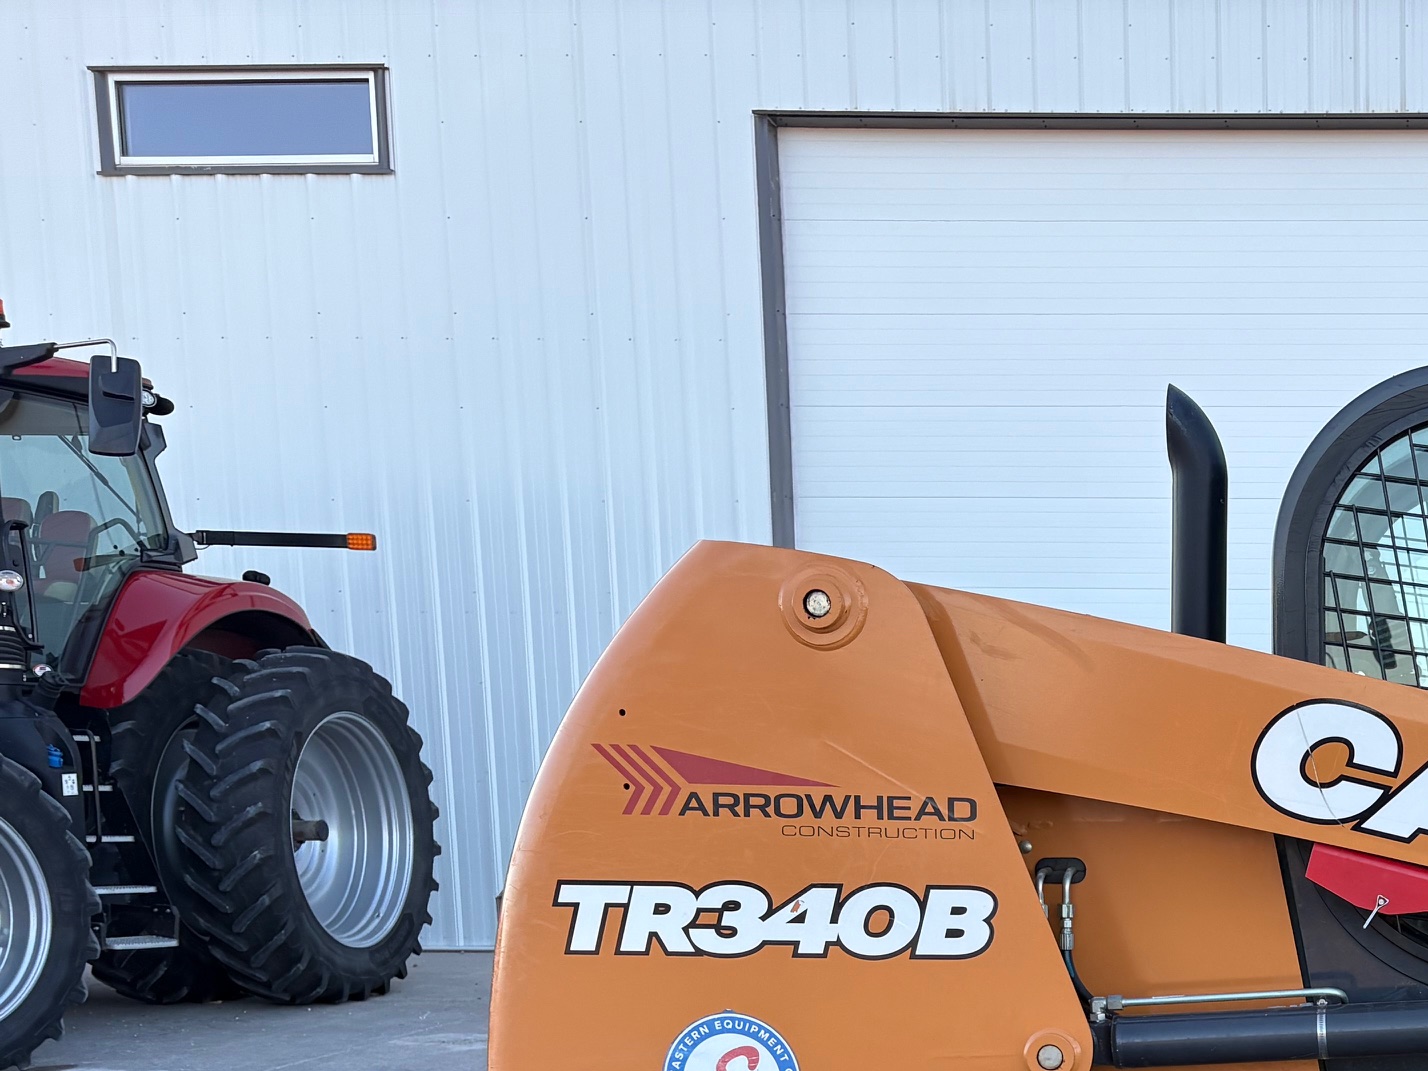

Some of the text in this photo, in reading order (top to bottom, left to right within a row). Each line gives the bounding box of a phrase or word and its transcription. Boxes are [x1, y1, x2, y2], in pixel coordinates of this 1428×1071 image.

[678, 792, 978, 822] ARROWHEAD
[781, 824, 975, 840] CONSTRUCTION
[552, 880, 998, 960] TR340B
[714, 1019, 789, 1062] EQUIPMENT
